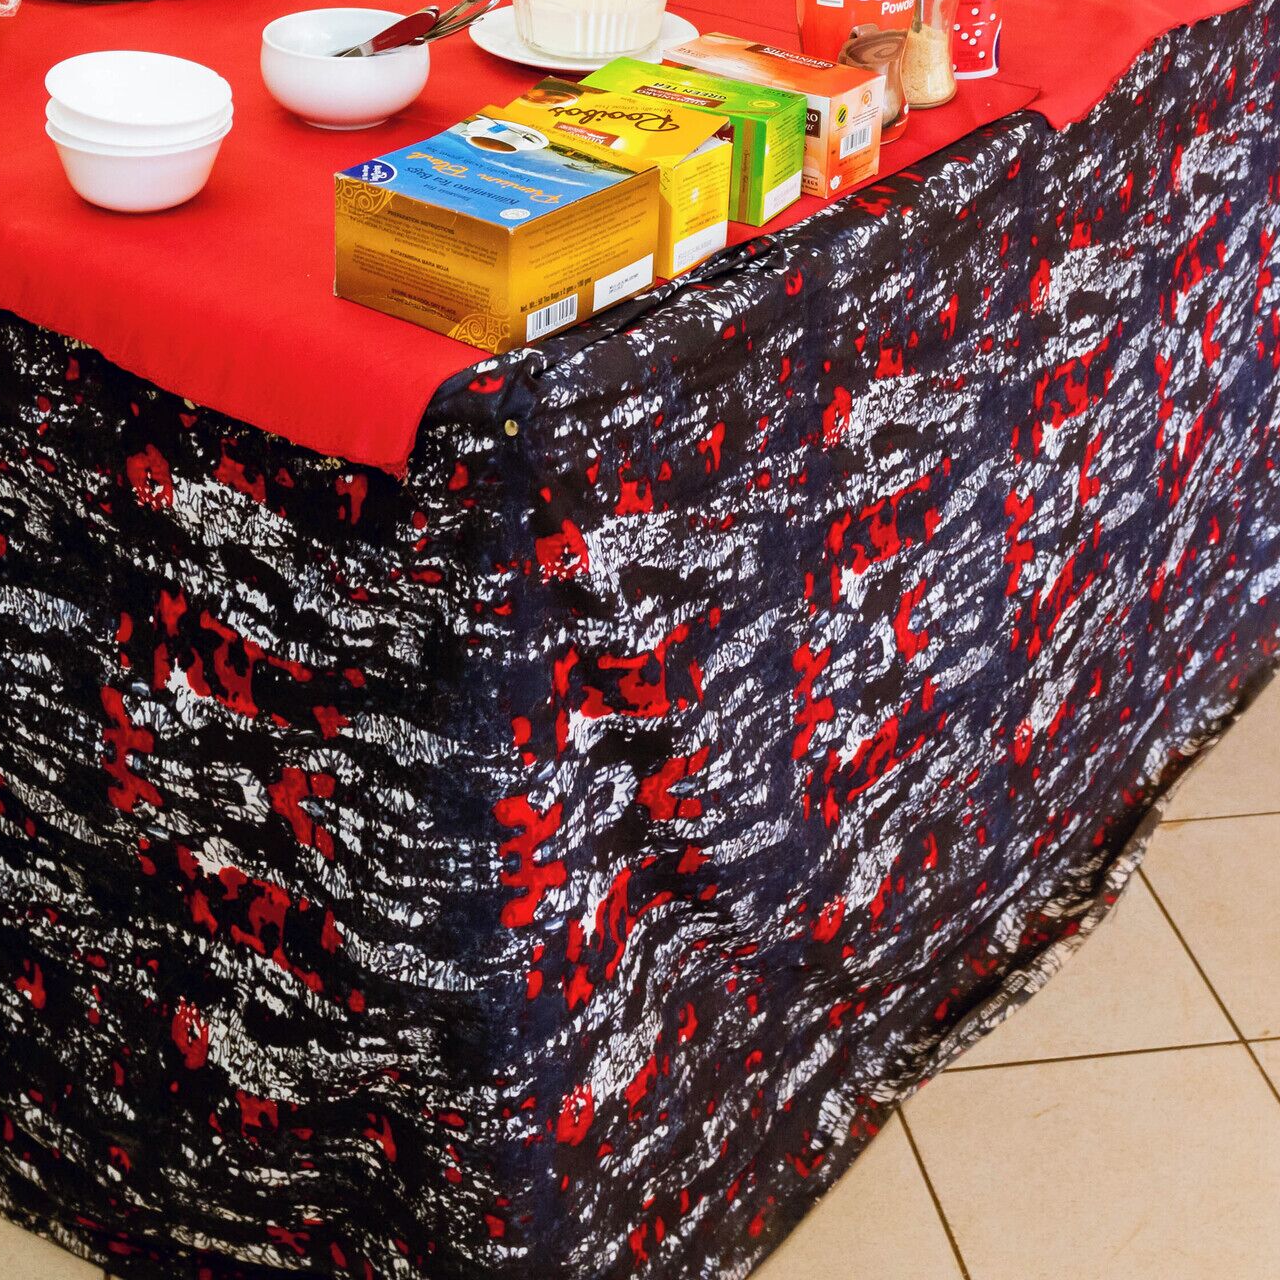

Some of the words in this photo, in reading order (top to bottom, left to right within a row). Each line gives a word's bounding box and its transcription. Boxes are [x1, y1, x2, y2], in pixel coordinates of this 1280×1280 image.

[763, 47, 833, 68] KILIMANJARO
[653, 82, 678, 90] TEA
[683, 88, 727, 100] GREEN
[636, 89, 708, 106] KILIMANJARO
[548, 107, 680, 132] Rooibos
[404, 166, 433, 179] Bags
[406, 151, 468, 179] Blend
[435, 175, 452, 187] Tea
[477, 173, 563, 204] Premium
[454, 182, 520, 205] Kilimanjaro
